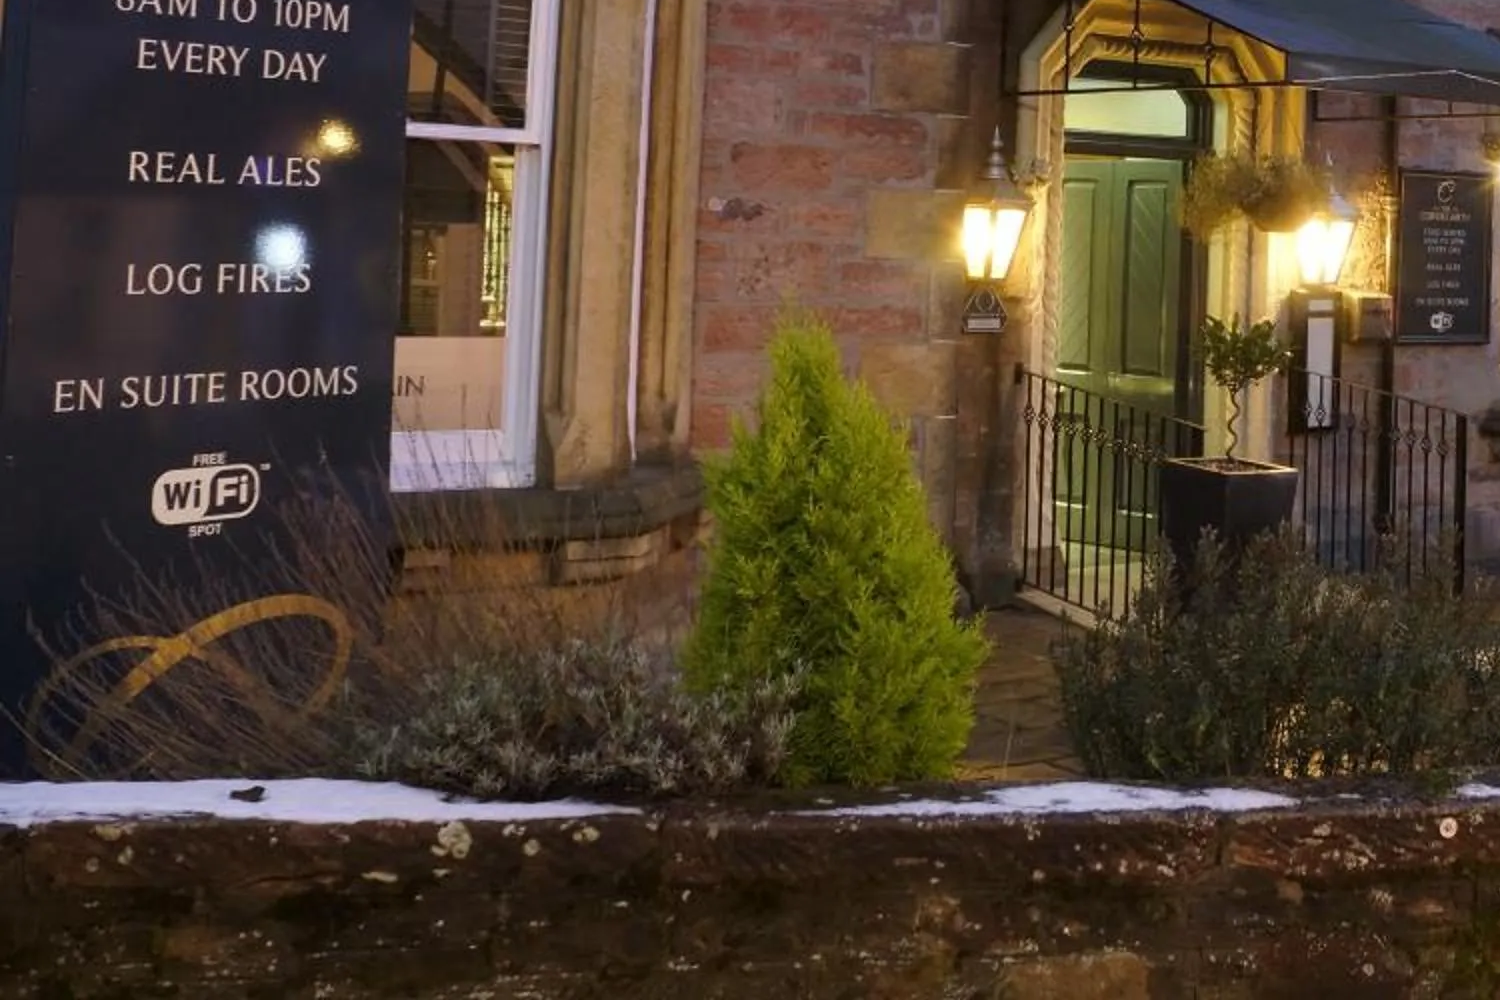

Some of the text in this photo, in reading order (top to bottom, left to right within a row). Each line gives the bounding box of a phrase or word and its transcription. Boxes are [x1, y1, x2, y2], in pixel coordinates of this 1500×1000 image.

[136, 38, 327, 83] EVERY DAY
[128, 151, 322, 187] REAL ALES
[126, 263, 312, 296] LOG FIRES
[53, 366, 359, 414] EN SUITE ROOMS
[192, 451, 228, 467] FREE
[188, 522, 223, 538] SPOT
